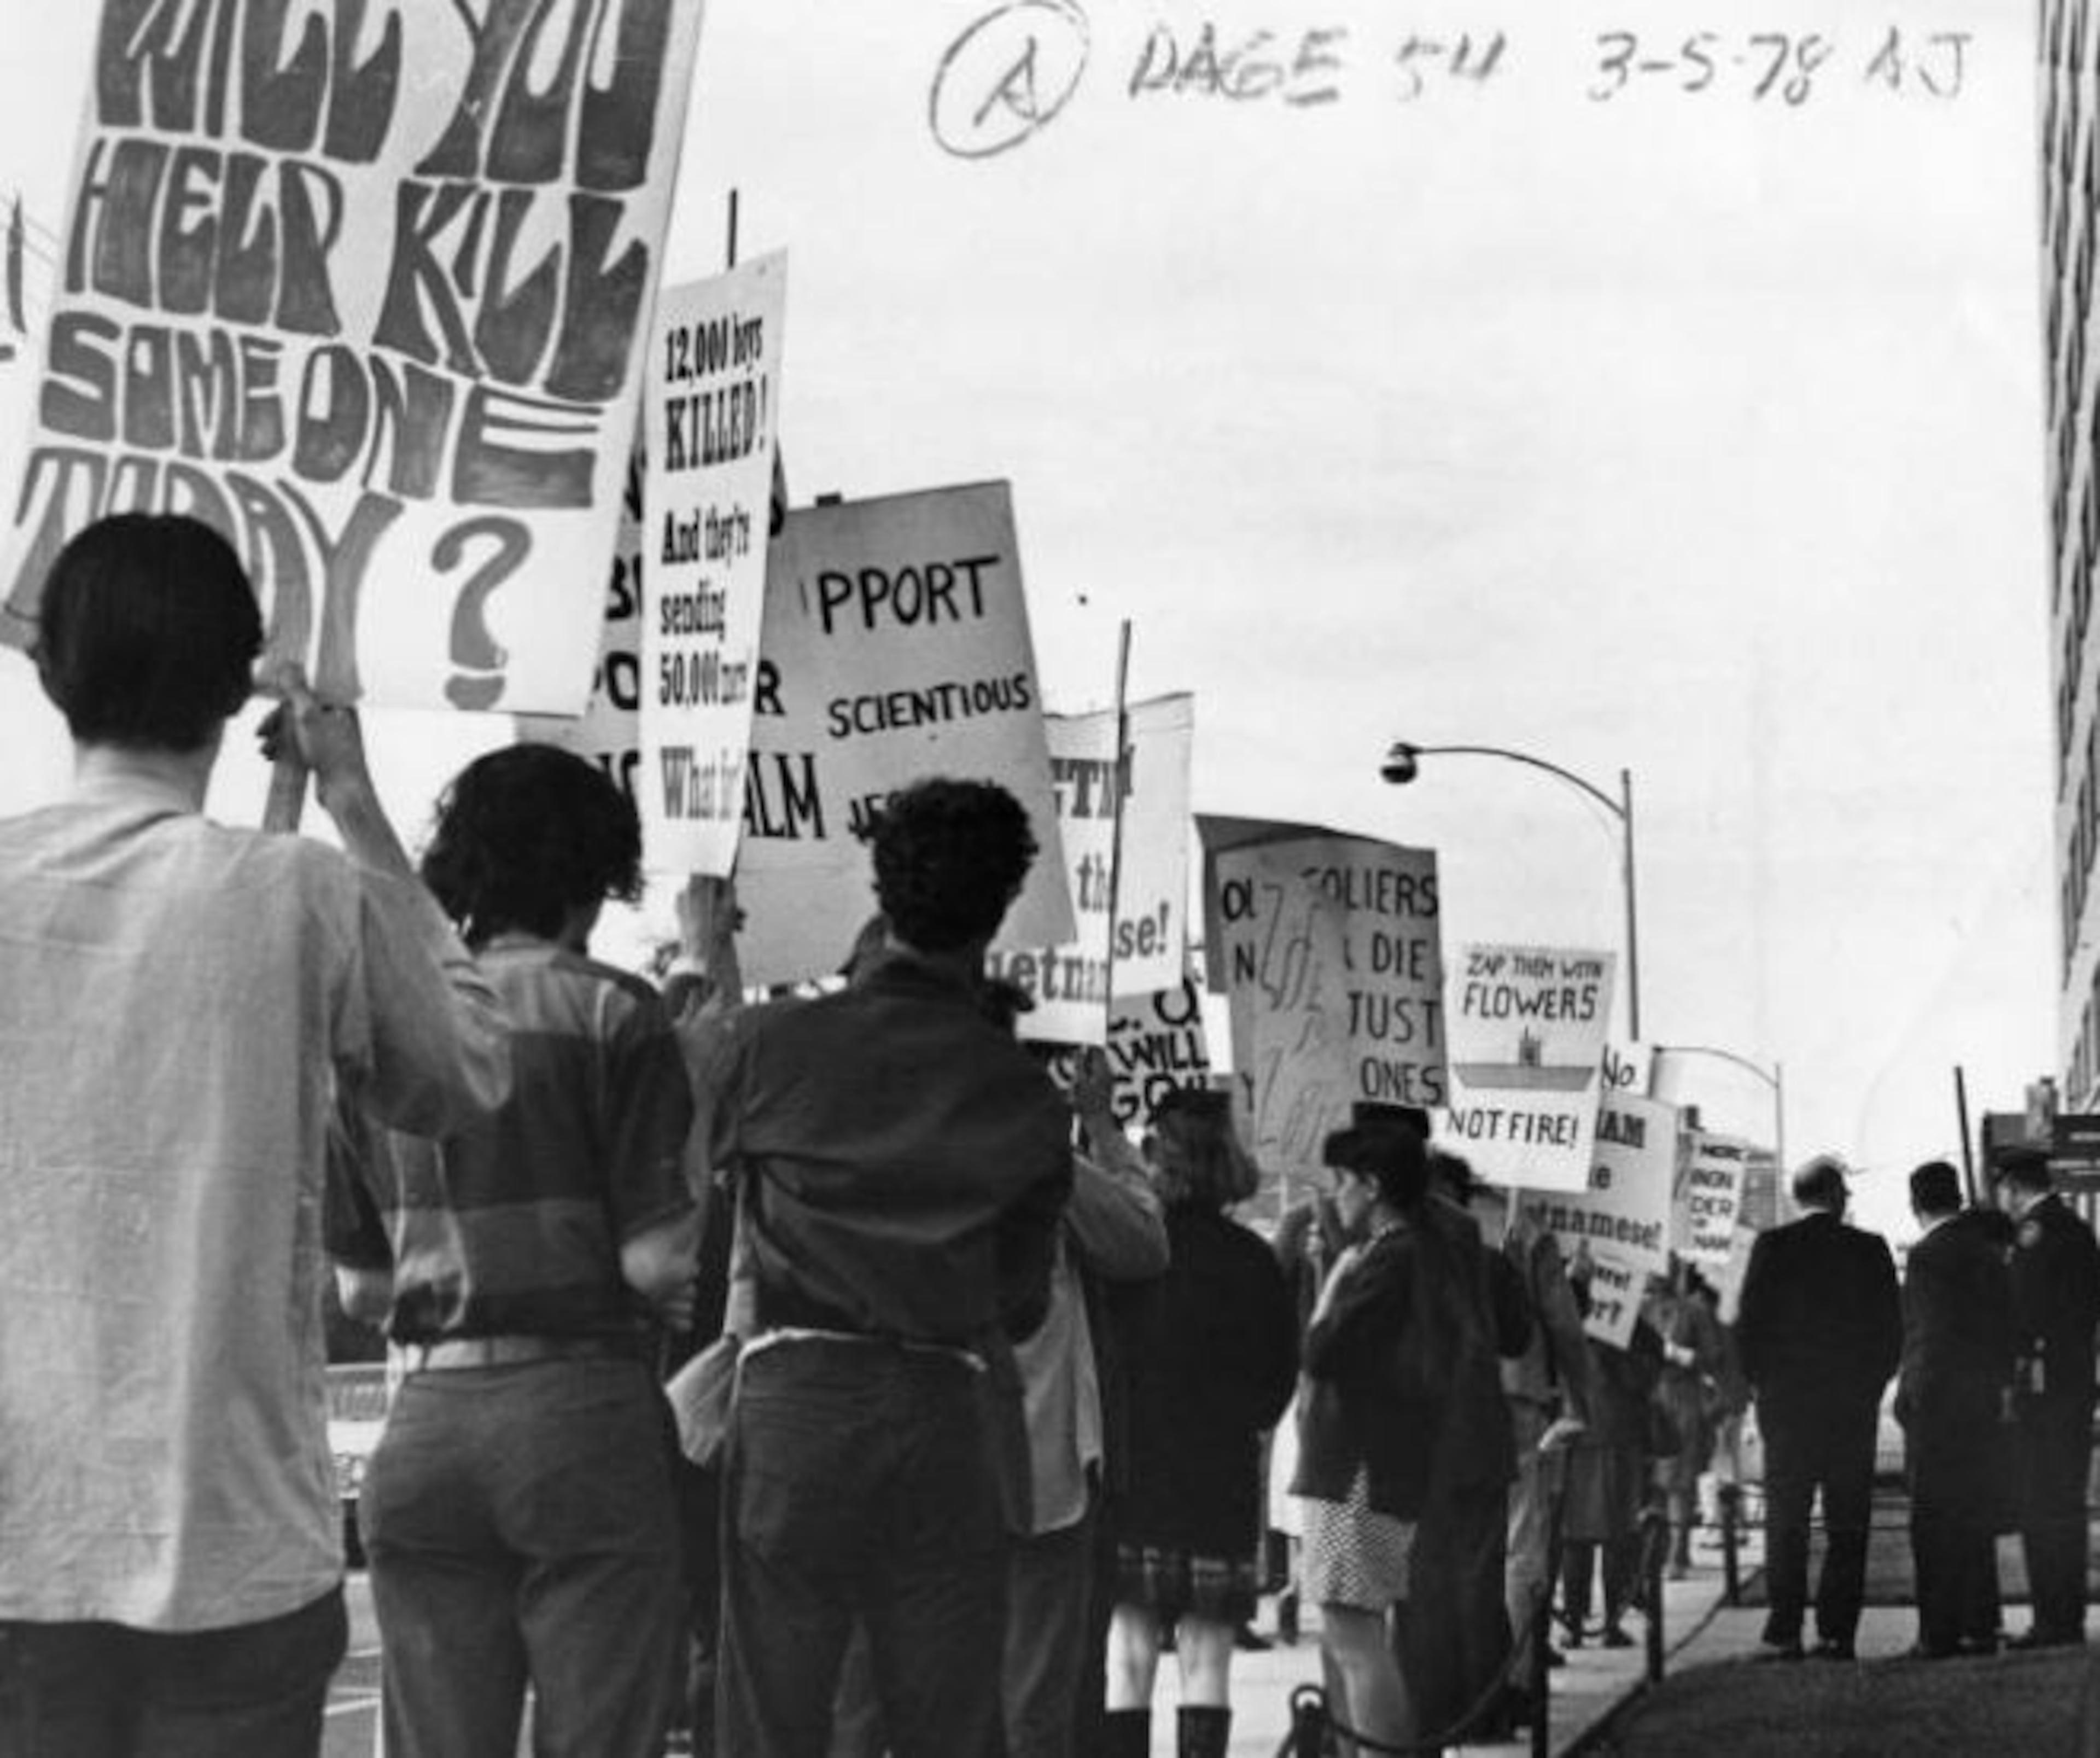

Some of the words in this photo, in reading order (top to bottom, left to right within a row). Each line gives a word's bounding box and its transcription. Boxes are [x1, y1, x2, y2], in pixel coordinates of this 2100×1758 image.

[97, 0, 403, 165] WILL
[413, 0, 675, 191] YOU
[66, 136, 343, 338] HELP
[372, 178, 651, 405] KILL
[664, 373, 767, 473] KILLED!
[661, 508, 700, 566] And
[827, 672, 1031, 740] SCIENTIOUS
[1372, 931, 1425, 981] DIE
[1462, 981, 1598, 1021] FLOWERS
[1360, 1057, 1442, 1106] ONES
[1448, 1107, 1504, 1140] NOT
[1508, 1111, 1579, 1150] FIRE!
